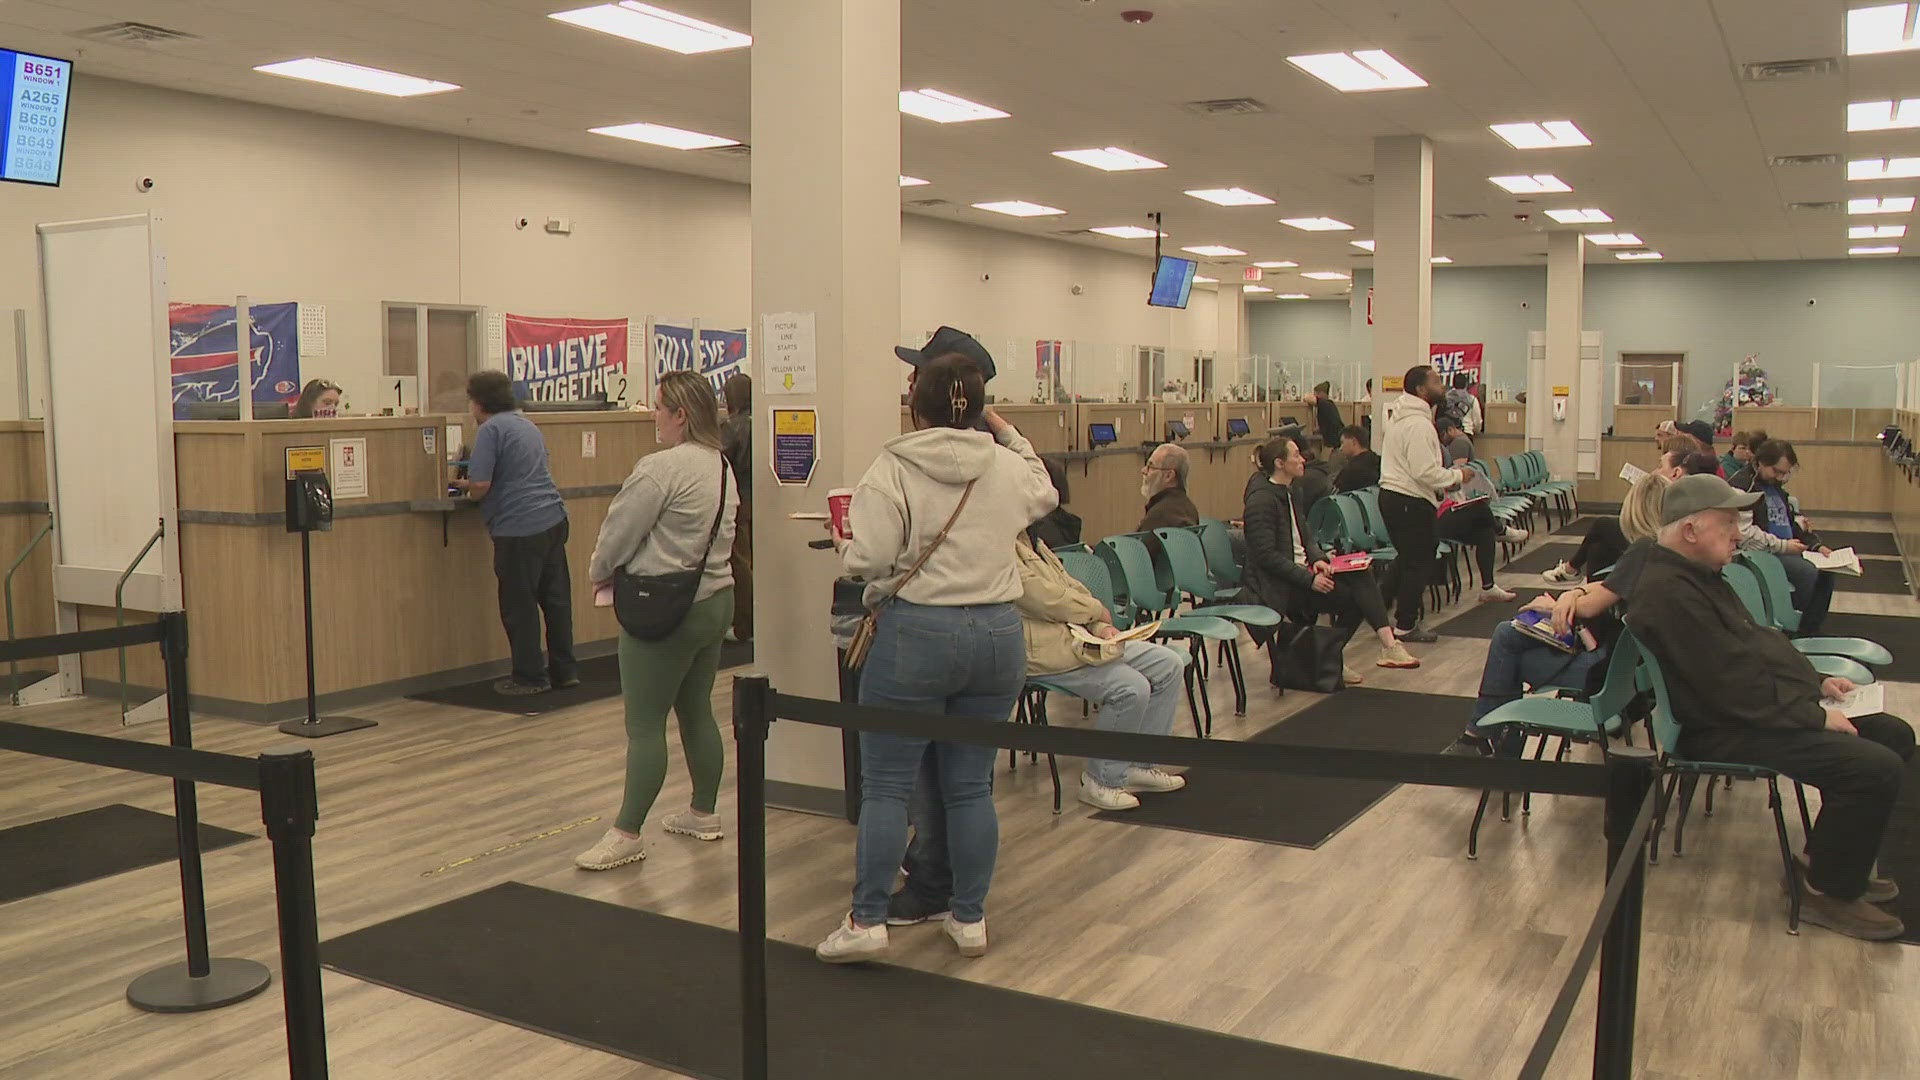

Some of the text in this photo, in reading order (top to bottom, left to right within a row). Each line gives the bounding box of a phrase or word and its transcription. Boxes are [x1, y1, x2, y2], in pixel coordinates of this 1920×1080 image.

[24, 61, 61, 79] B651
[23, 75, 54, 85] WINDOW
[20, 89, 60, 106] A265
[20, 102, 52, 113] WINDOW
[19, 112, 57, 128] B650
[18, 125, 49, 135] WINDOW
[17, 134, 54, 150] B649
[16, 147, 47, 156] WINDOW
[511, 332, 608, 382] BILLIEVE
[394, 380, 402, 407] 1
[617, 378, 627, 401] 2
[1037, 382, 1042, 397] 5
[1122, 382, 1127, 397] 6
[1242, 384, 1248, 397] 8
[1291, 385, 1297, 396] 9
[1494, 390, 1503, 400] 11
